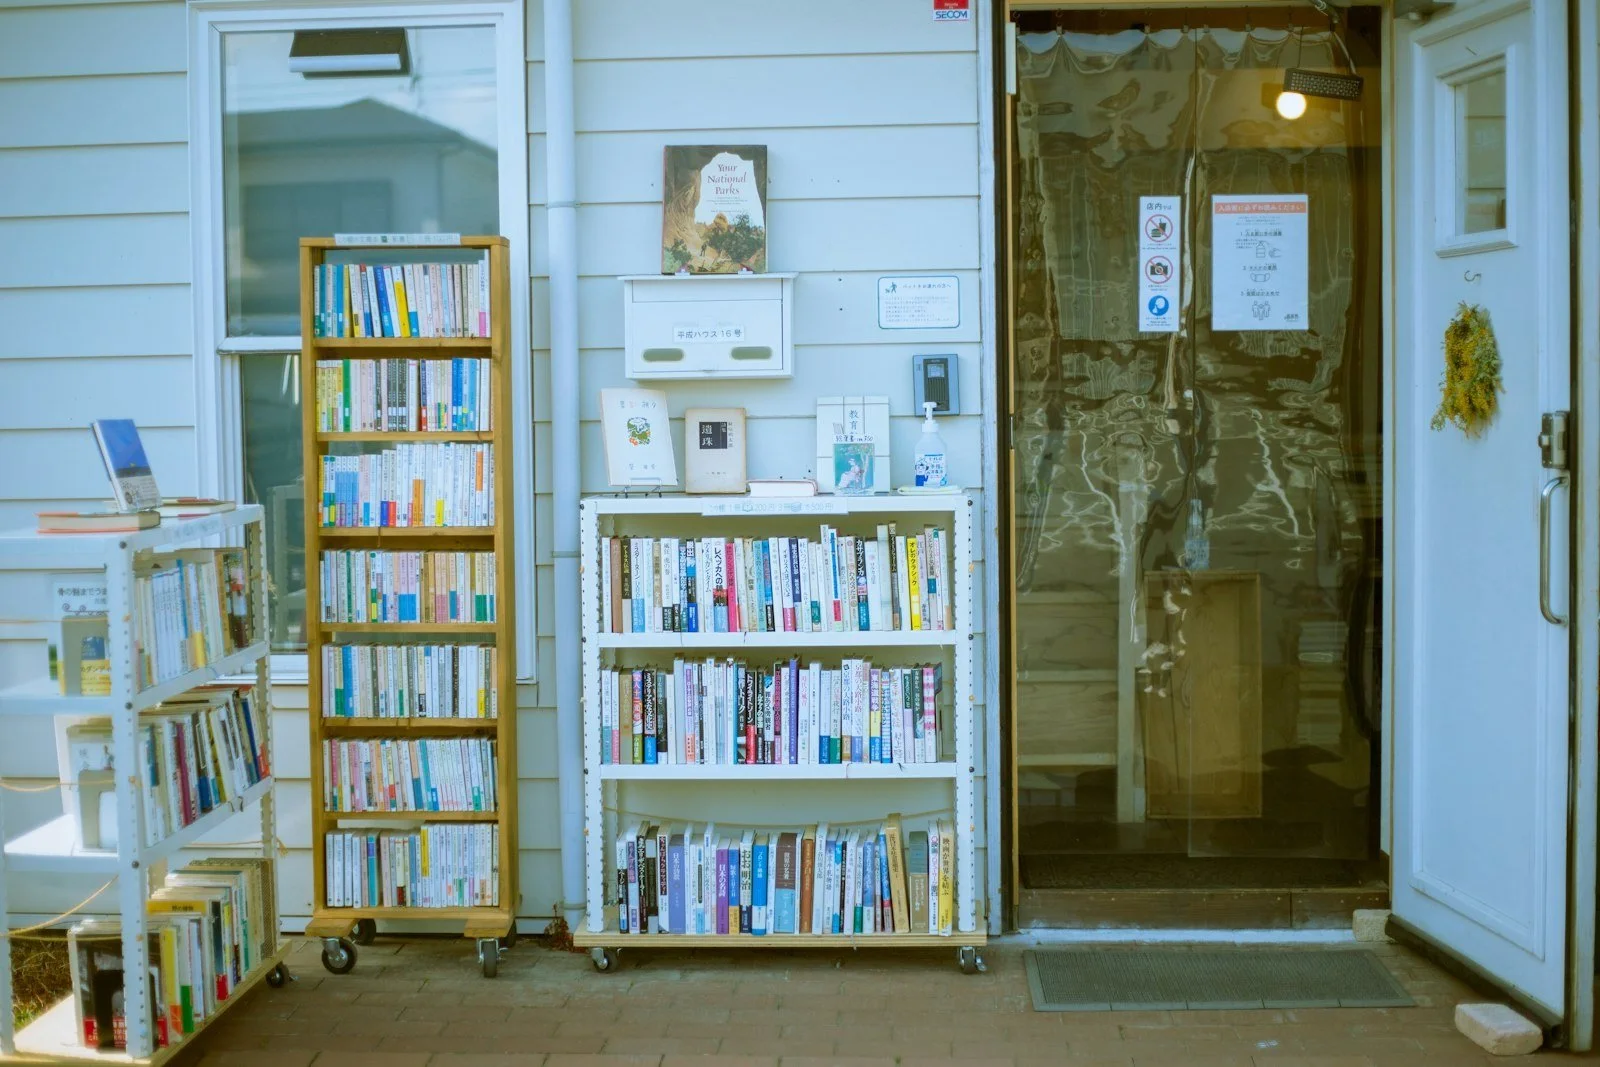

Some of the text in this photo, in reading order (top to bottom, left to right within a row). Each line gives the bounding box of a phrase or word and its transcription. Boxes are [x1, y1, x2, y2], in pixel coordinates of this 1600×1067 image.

[936, 10, 967, 19] SECOM
[718, 164, 738, 172] Your
[707, 171, 747, 184] National
[715, 183, 740, 194] Parks
[850, 410, 859, 434] 教育
[856, 540, 864, 576] カサブランカ
[718, 864, 726, 897] 日本の名詩
